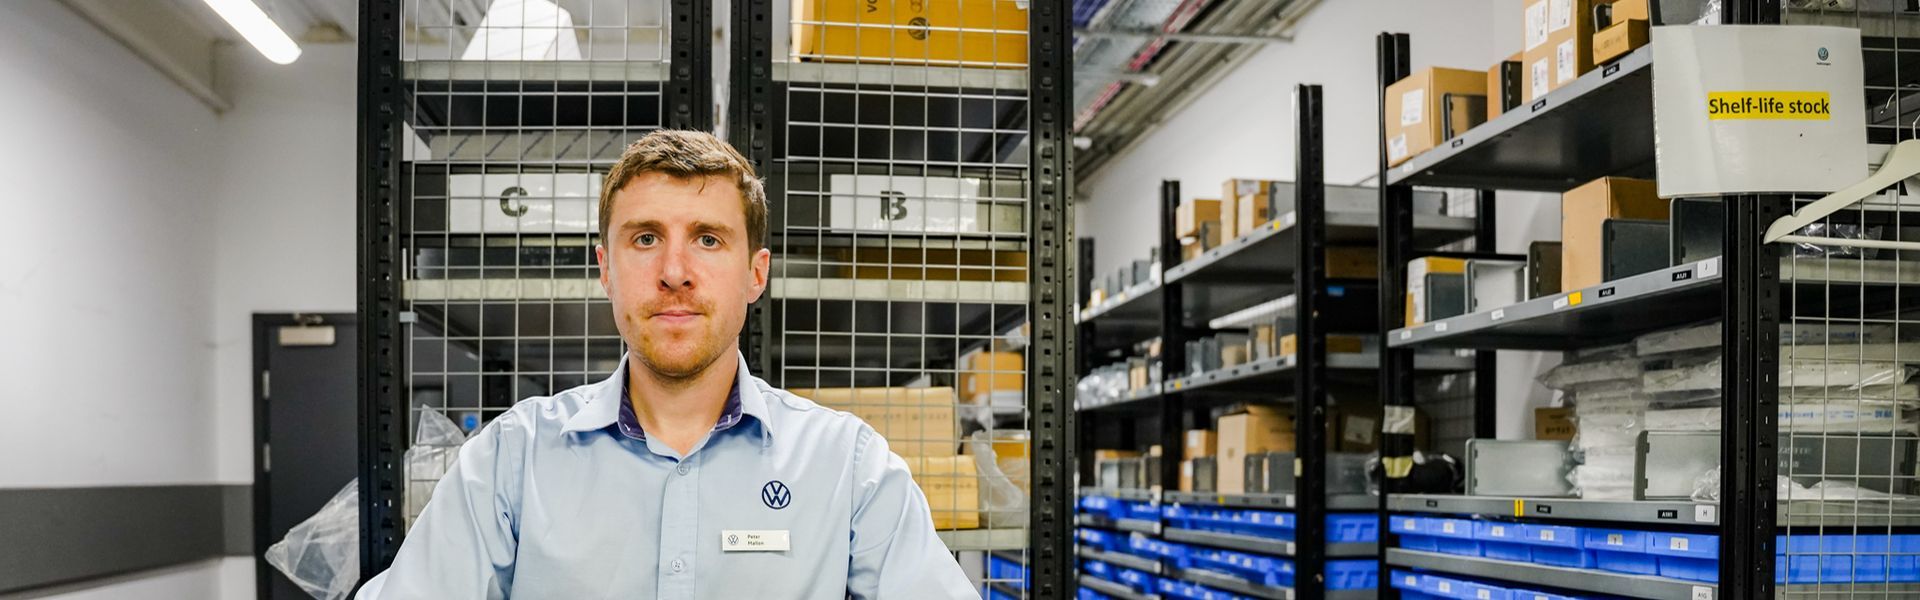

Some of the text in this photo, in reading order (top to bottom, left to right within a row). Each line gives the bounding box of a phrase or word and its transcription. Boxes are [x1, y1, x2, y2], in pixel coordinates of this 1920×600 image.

[1709, 97, 1830, 114] Shelf-life stock
[500, 186, 528, 217] C
[880, 190, 907, 221] B
